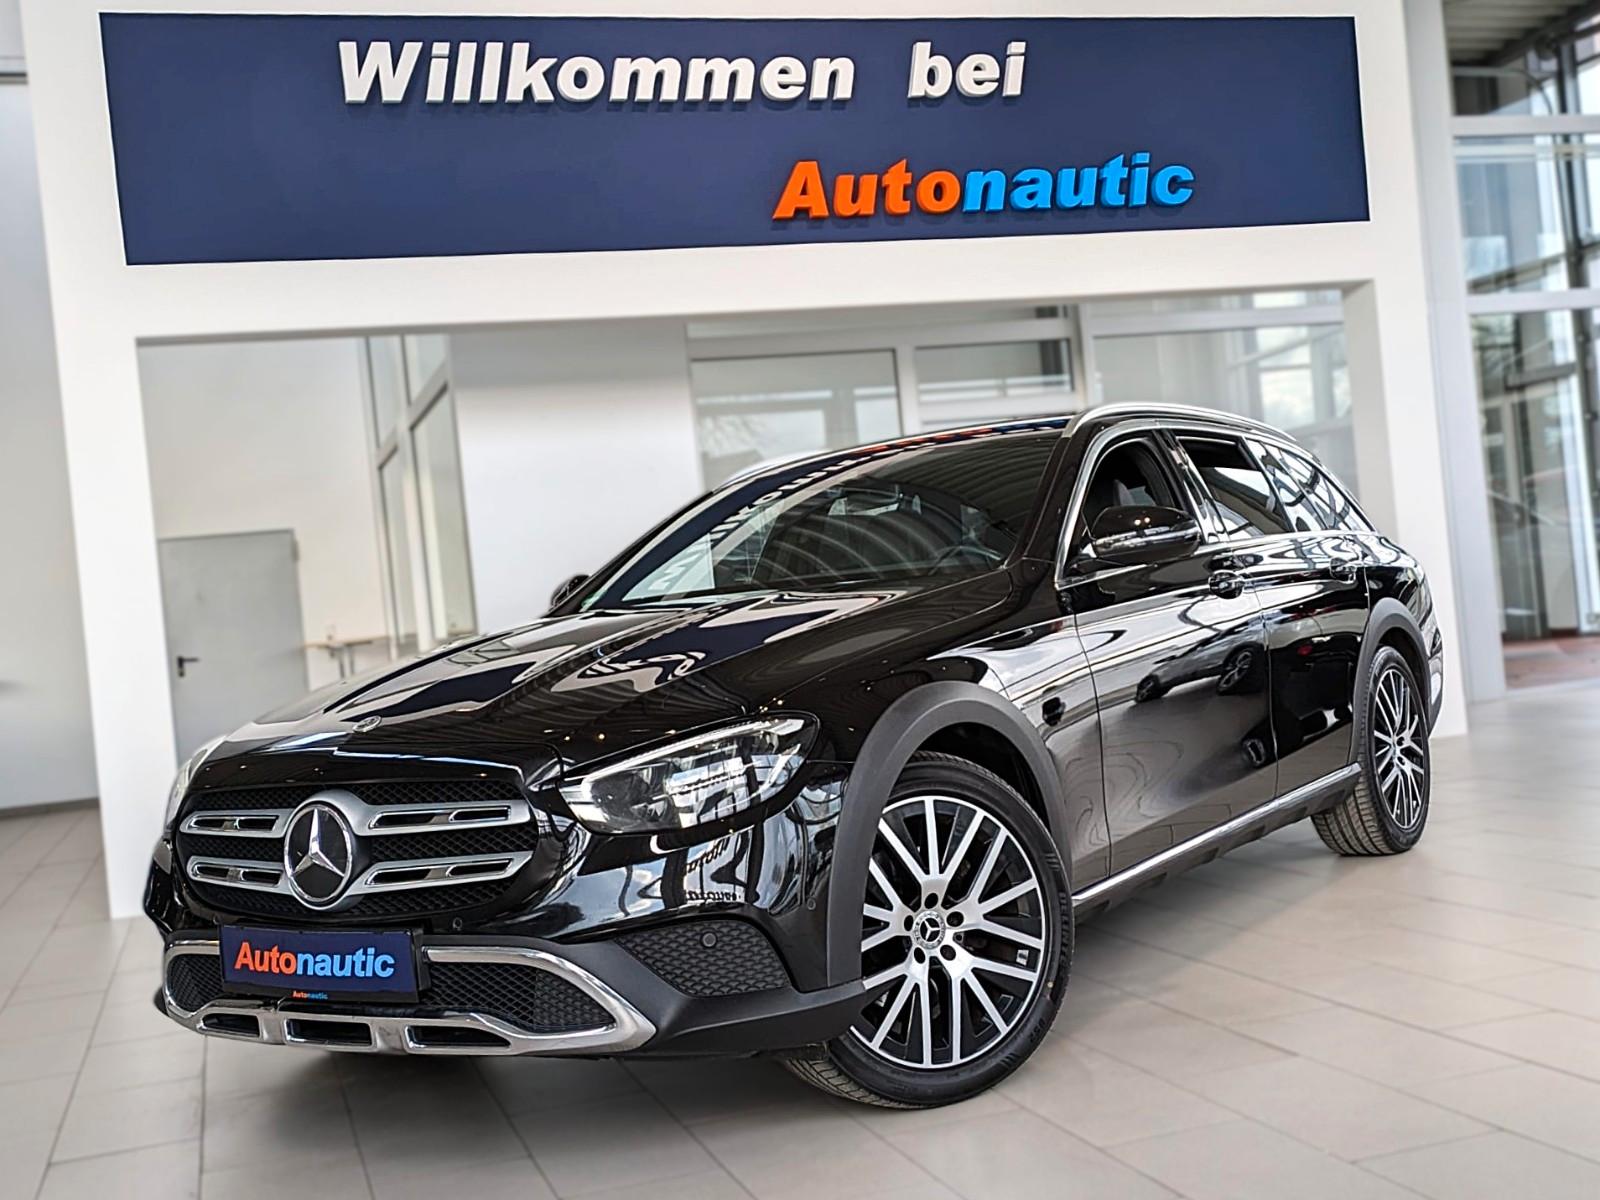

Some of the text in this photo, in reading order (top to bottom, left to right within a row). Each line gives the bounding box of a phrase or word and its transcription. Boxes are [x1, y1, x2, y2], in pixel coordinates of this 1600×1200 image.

[338, 41, 1027, 104] Willkommen bei
[772, 152, 1195, 220] Autonautic
[234, 942, 395, 978] Autonautic
[292, 990, 329, 1000] Autonautic
